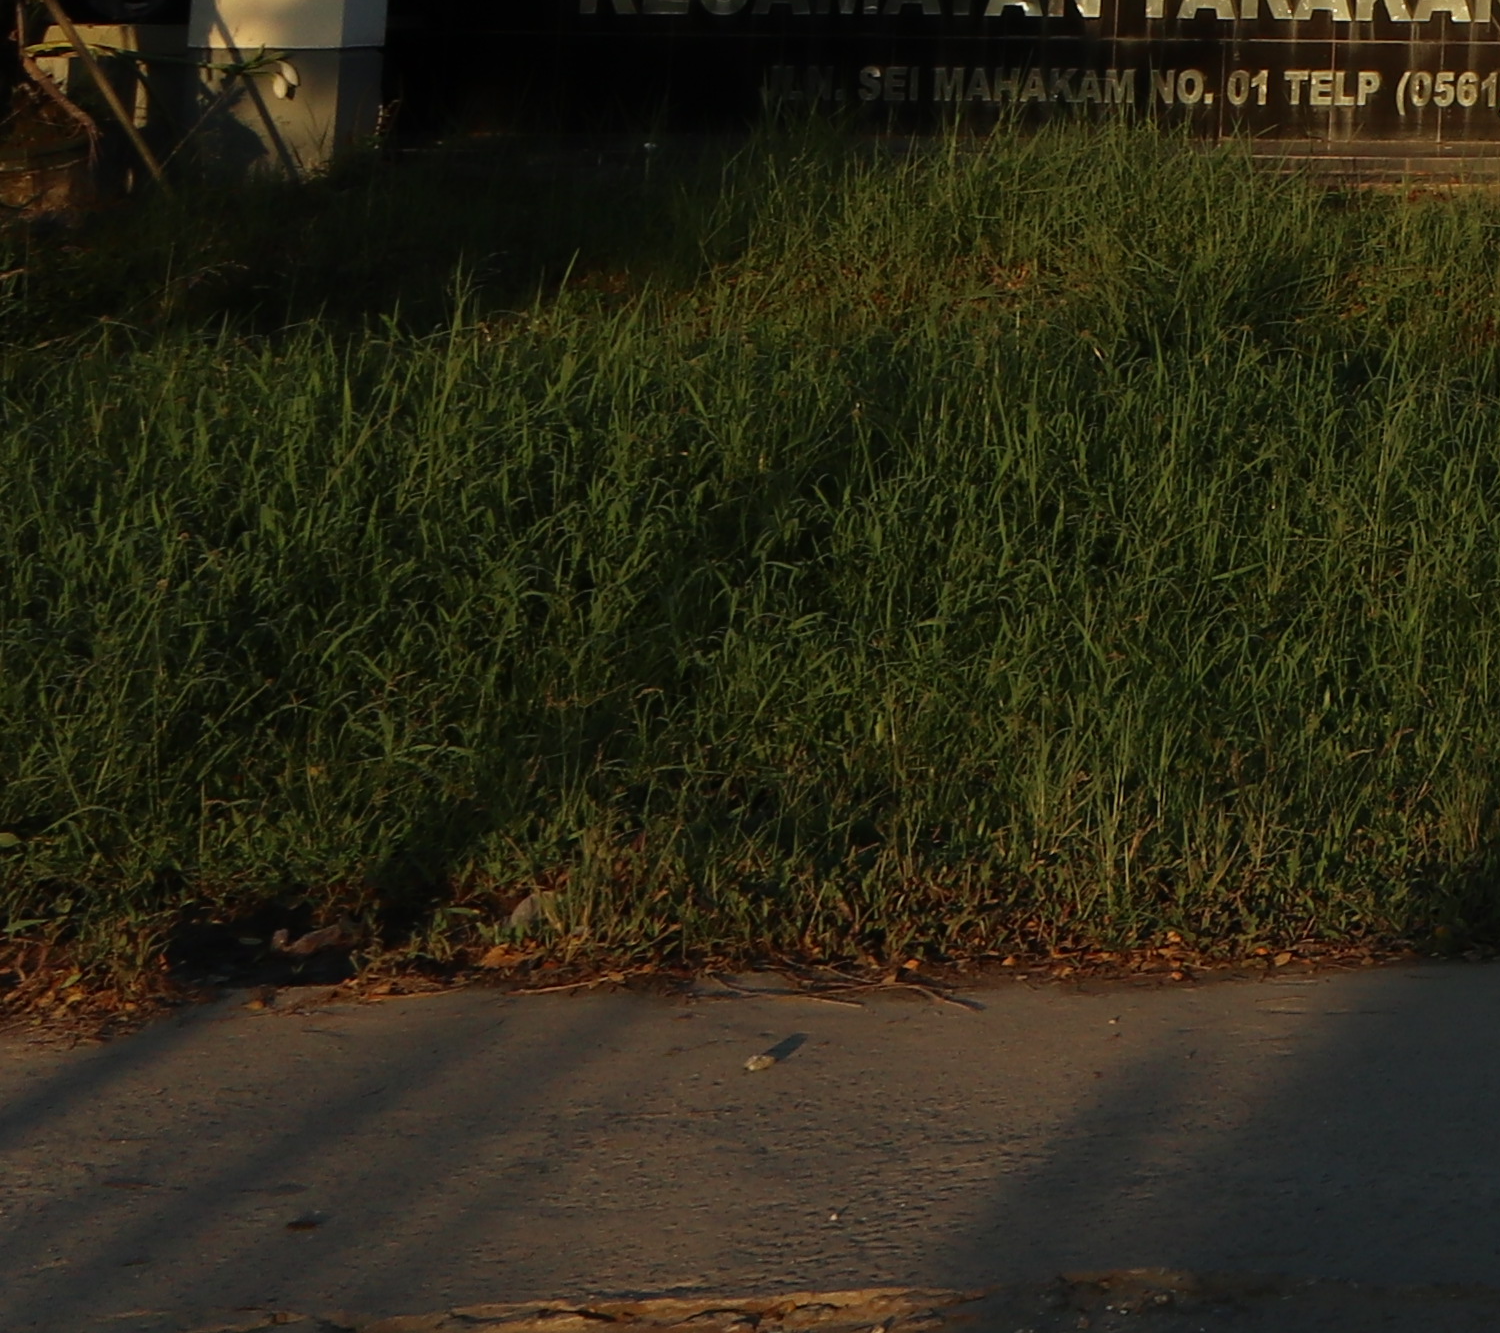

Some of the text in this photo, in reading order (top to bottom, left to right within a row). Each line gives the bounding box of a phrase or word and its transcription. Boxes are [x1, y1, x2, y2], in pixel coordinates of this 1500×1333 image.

[857, 65, 919, 103] SEI
[932, 66, 1137, 106] MAHAKAM
[1155, 69, 1214, 106] NO.
[1226, 69, 1270, 106] 01
[1283, 70, 1380, 108] TELP
